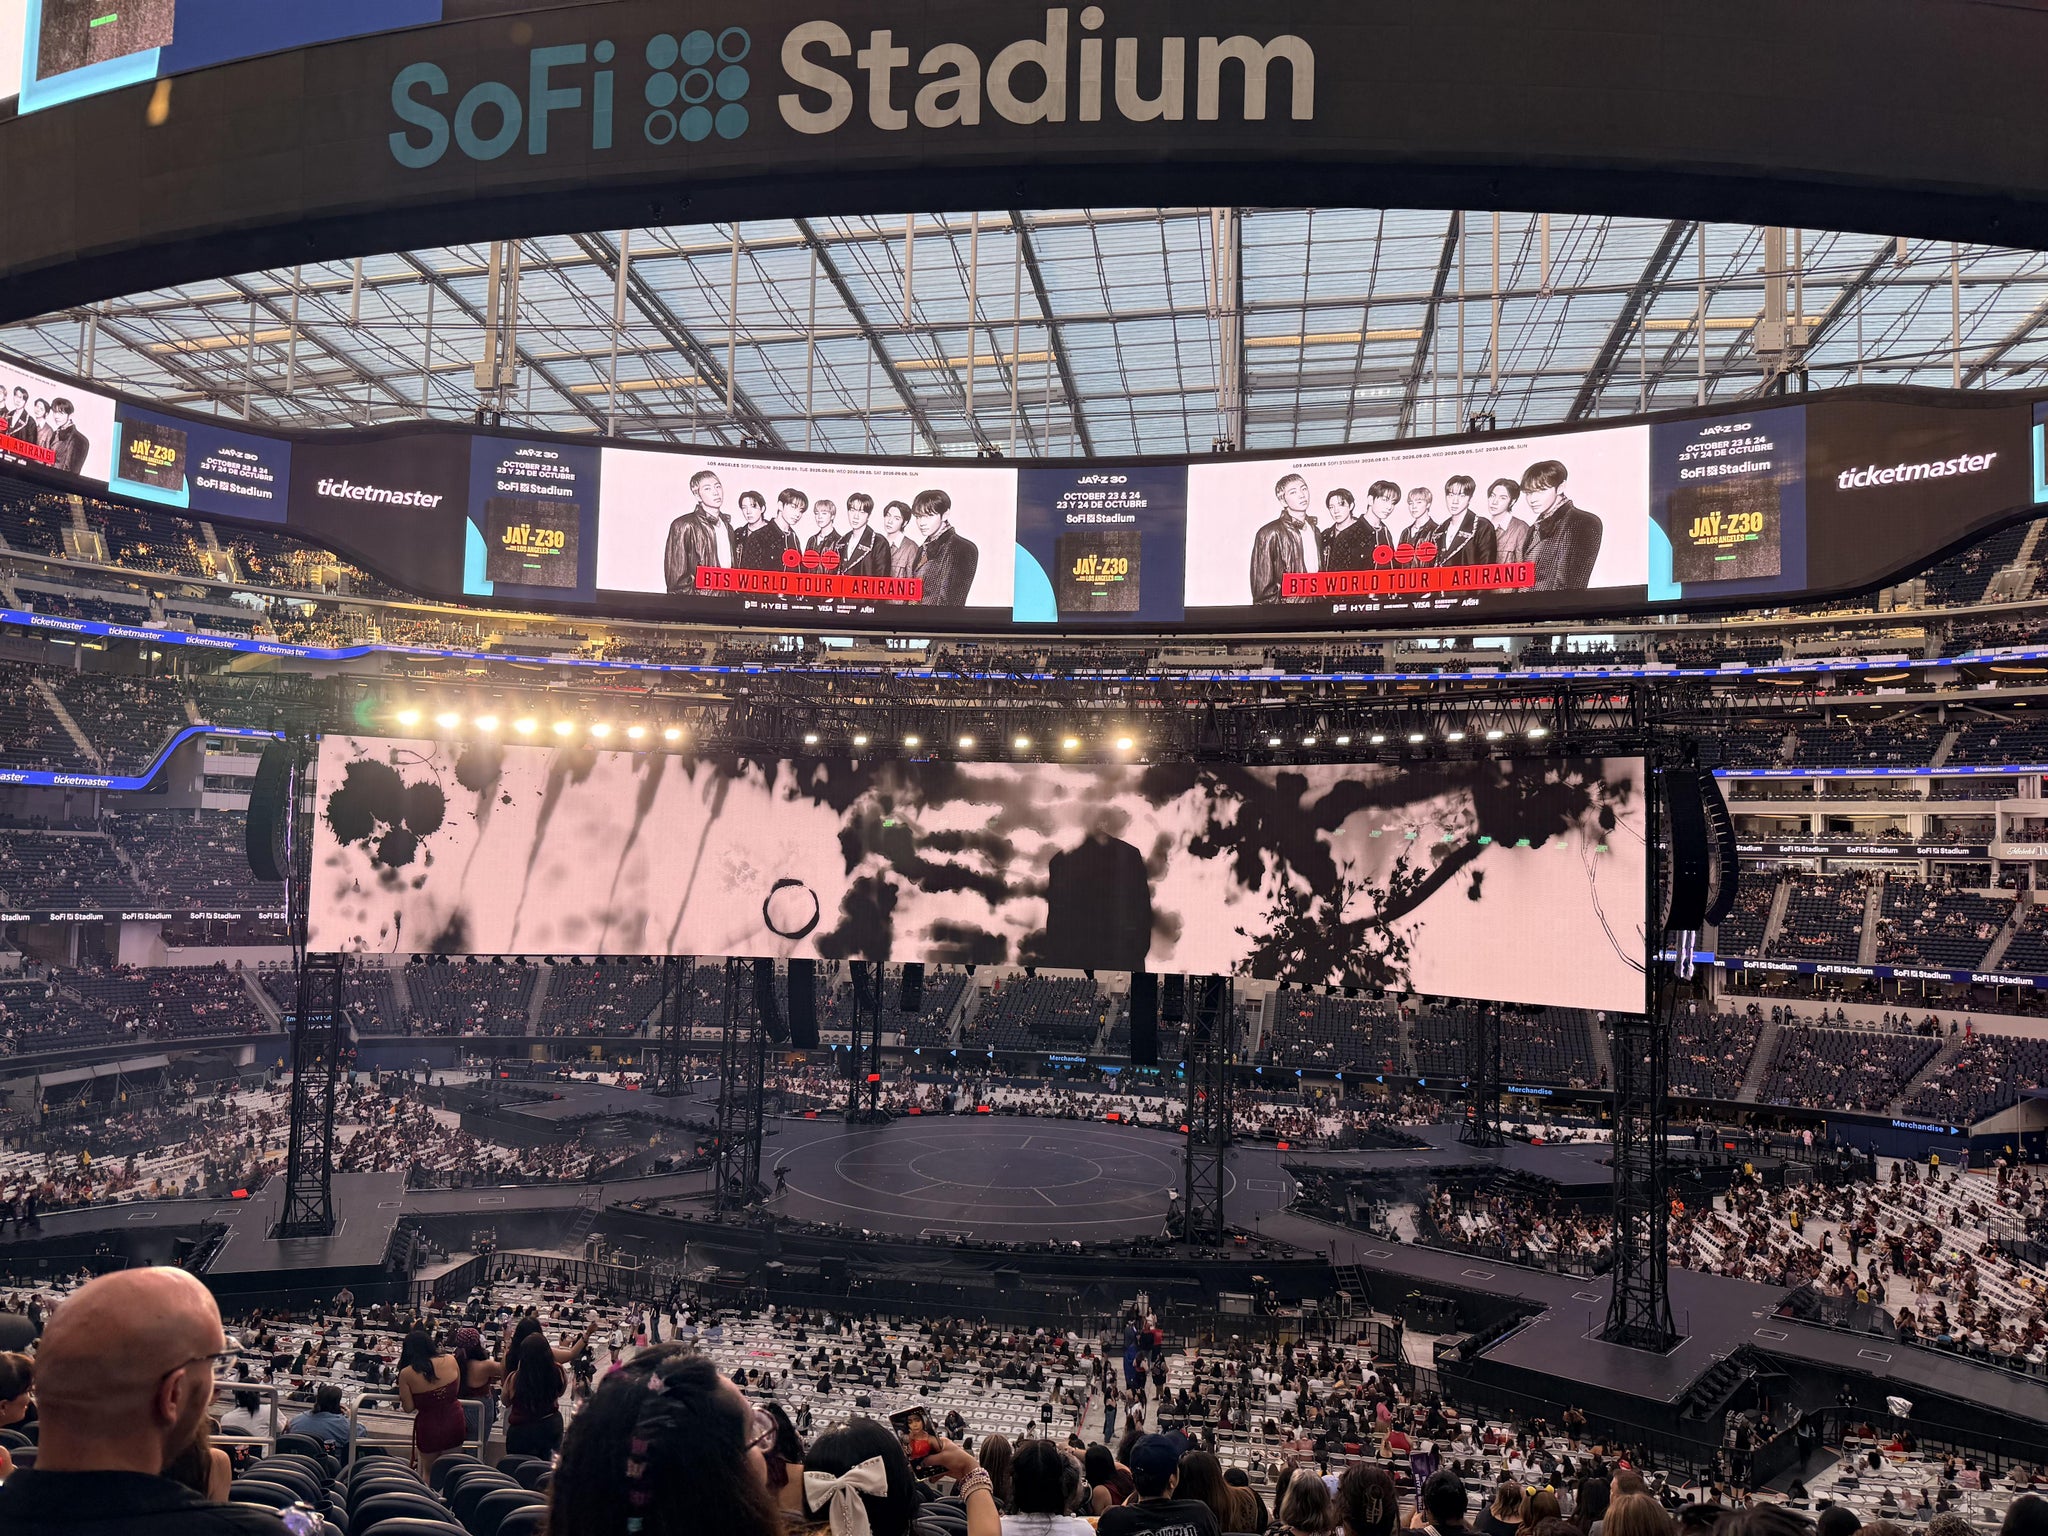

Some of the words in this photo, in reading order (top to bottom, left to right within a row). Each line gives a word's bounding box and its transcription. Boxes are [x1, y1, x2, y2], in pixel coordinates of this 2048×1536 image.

[389, 39, 615, 168] SoFi
[778, 6, 1315, 134] Stadium
[1733, 423, 1752, 432] 30
[13, 440, 51, 461] ARIRANG
[1686, 440, 1729, 452] OCTOBER
[1731, 438, 1743, 447] 23
[1753, 436, 1766, 444] 24
[244, 453, 258, 461] 30
[543, 451, 558, 459] 30
[1678, 453, 1691, 461] 23
[1692, 451, 1699, 459] Y
[1700, 450, 1712, 458] 24
[1714, 448, 1726, 457] DE
[1728, 443, 1773, 455] OCTUBRE
[207, 457, 240, 469] OCTOBER
[503, 460, 540, 471] OCTOBER
[541, 464, 551, 472] 23
[240, 470, 273, 481] OCTUBRE
[515, 468, 525, 476] 24
[539, 470, 576, 481] OCTUBRE
[1680, 467, 1705, 480] SoFi
[1718, 460, 1771, 475] Stadium
[1837, 451, 1997, 490] ticketmaster
[1109, 475, 1127, 484] 30
[197, 476, 218, 489] SoFi
[229, 483, 273, 499] Stadium
[317, 478, 442, 508] ticketmaster
[497, 480, 518, 492] SoFi
[530, 484, 573, 497] Stadium
[1063, 492, 1106, 501] OCTOBER
[1107, 491, 1119, 500] 23
[1121, 491, 1128, 499] &
[1129, 491, 1141, 499] 24
[1056, 501, 1068, 509] 23
[1069, 501, 1076, 509] Y
[1077, 500, 1089, 509] 24
[1092, 500, 1103, 509] DE
[1104, 499, 1147, 508] OCTUBRE
[1066, 514, 1086, 524] SoFi
[1096, 513, 1135, 523] Stadium
[1688, 511, 1764, 538] JAŸ-Z30
[502, 523, 565, 548] JAŸ-Z30
[1706, 536, 1718, 545] LOS
[1718, 533, 1745, 544] ANGELES
[1072, 554, 1128, 575] JAŸ-Z30
[704, 572, 730, 588] BTS
[738, 573, 788, 592] WORLD
[796, 576, 833, 593] TOUR
[852, 578, 916, 597] ARIRANG
[1290, 578, 1317, 593] BTS
[1325, 574, 1379, 592] WORLD
[1388, 570, 1429, 590] TOUR
[1452, 565, 1527, 586] ARIRANG
[761, 602, 788, 610] HYBE
[817, 604, 833, 612] VISA
[30, 616, 85, 631] ticketmaster
[108, 626, 162, 640] ticketmaster
[185, 635, 237, 649] ticketmaster
[258, 643, 308, 656] ticketmaster
[53, 774, 110, 787] ticketmaster
[1, 913, 30, 921] Stadium
[1744, 960, 1759, 968] SoFi
[1768, 962, 1797, 971] Stadium
[1817, 964, 1833, 972] SoFi
[1842, 966, 1873, 975] Stadium
[1893, 969, 1909, 977] SoFi
[1919, 970, 1950, 979] Stadium
[1972, 974, 1989, 983] SoFi
[1999, 976, 2033, 985] Stadium
[1049, 1054, 1086, 1063] Merchandise
[1508, 1085, 1553, 1095] Merchandise
[1892, 1119, 1944, 1133] Merchandise
